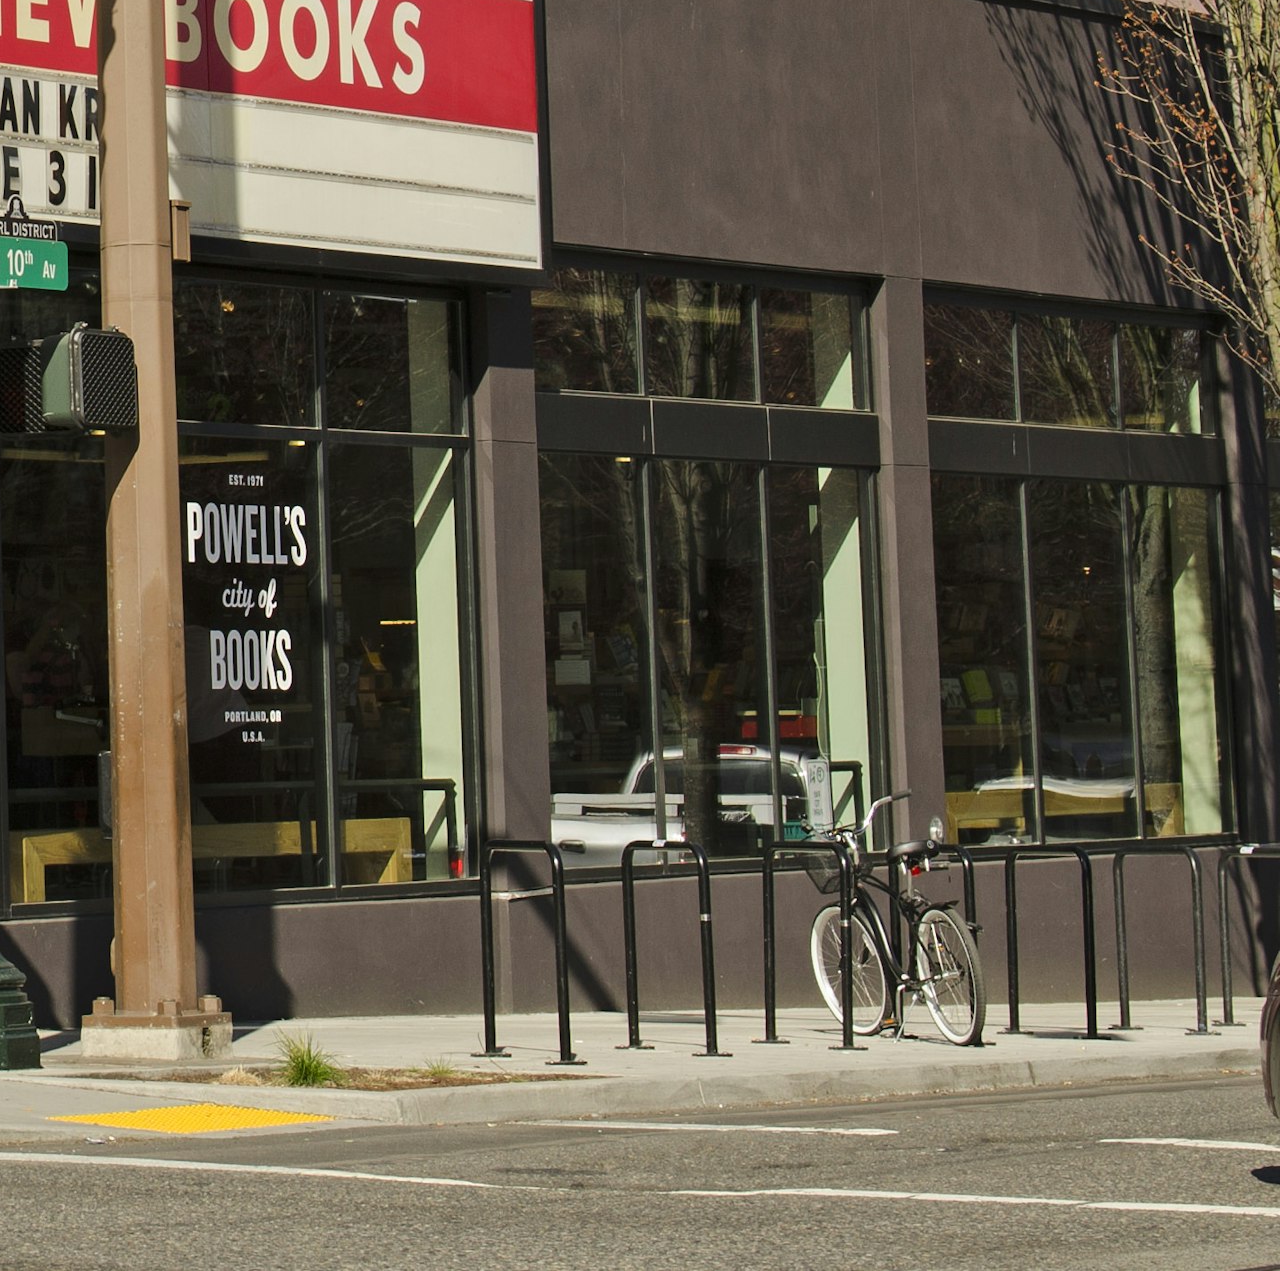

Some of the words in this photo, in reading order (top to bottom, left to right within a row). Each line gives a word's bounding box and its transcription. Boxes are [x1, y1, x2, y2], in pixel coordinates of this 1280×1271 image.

[14, 221, 55, 239] DISTRICT
[6, 248, 34, 277] 10th
[42, 260, 56, 279] Av
[228, 474, 245, 486] EST.
[247, 475, 264, 487] 1971
[186, 502, 308, 567] POWELL'S
[222, 578, 255, 617] city
[257, 578, 278, 618] of
[210, 629, 293, 692] BOOKS
[224, 710, 269, 724] PORTLAND,
[269, 709, 282, 723] OR
[242, 731, 266, 743] U.S.A.
